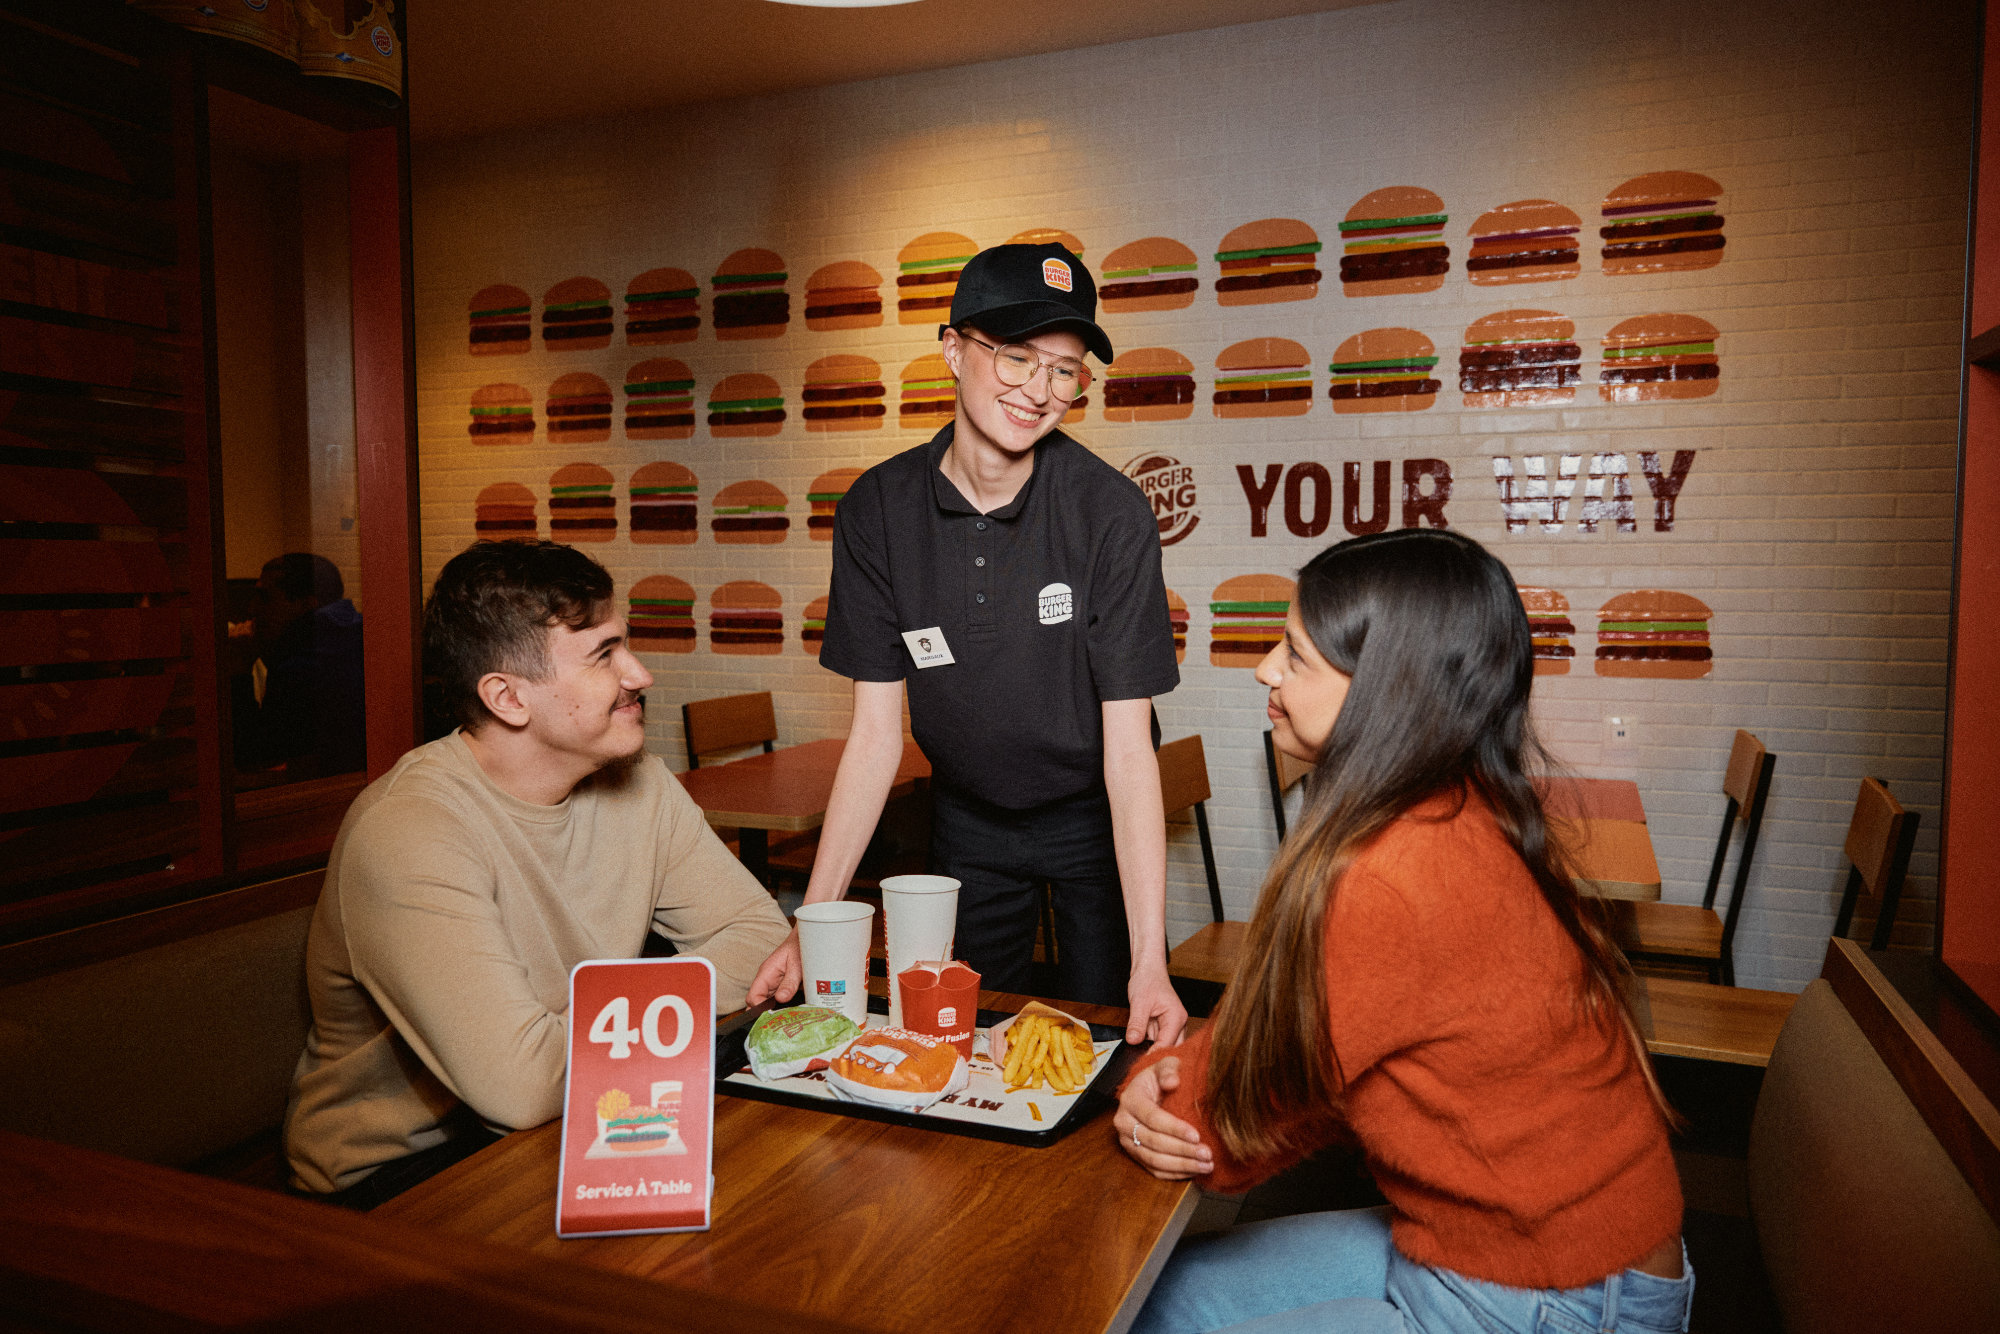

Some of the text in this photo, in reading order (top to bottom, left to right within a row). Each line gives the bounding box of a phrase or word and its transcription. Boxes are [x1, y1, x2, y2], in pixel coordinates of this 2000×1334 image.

[1044, 267, 1071, 278] BURGER
[1045, 273, 1071, 286] KING
[1140, 467, 1193, 493] RGER
[1147, 484, 1196, 516] NG
[1235, 449, 1697, 538] YOUR WAY
[1038, 593, 1072, 606] BURGER
[1038, 602, 1073, 618] KING
[588, 994, 695, 1059] 40
[938, 1016, 956, 1024] KING
[945, 1031, 970, 1043] Fusion
[958, 1097, 1004, 1111] MY
[575, 1178, 693, 1200] Service À Table
